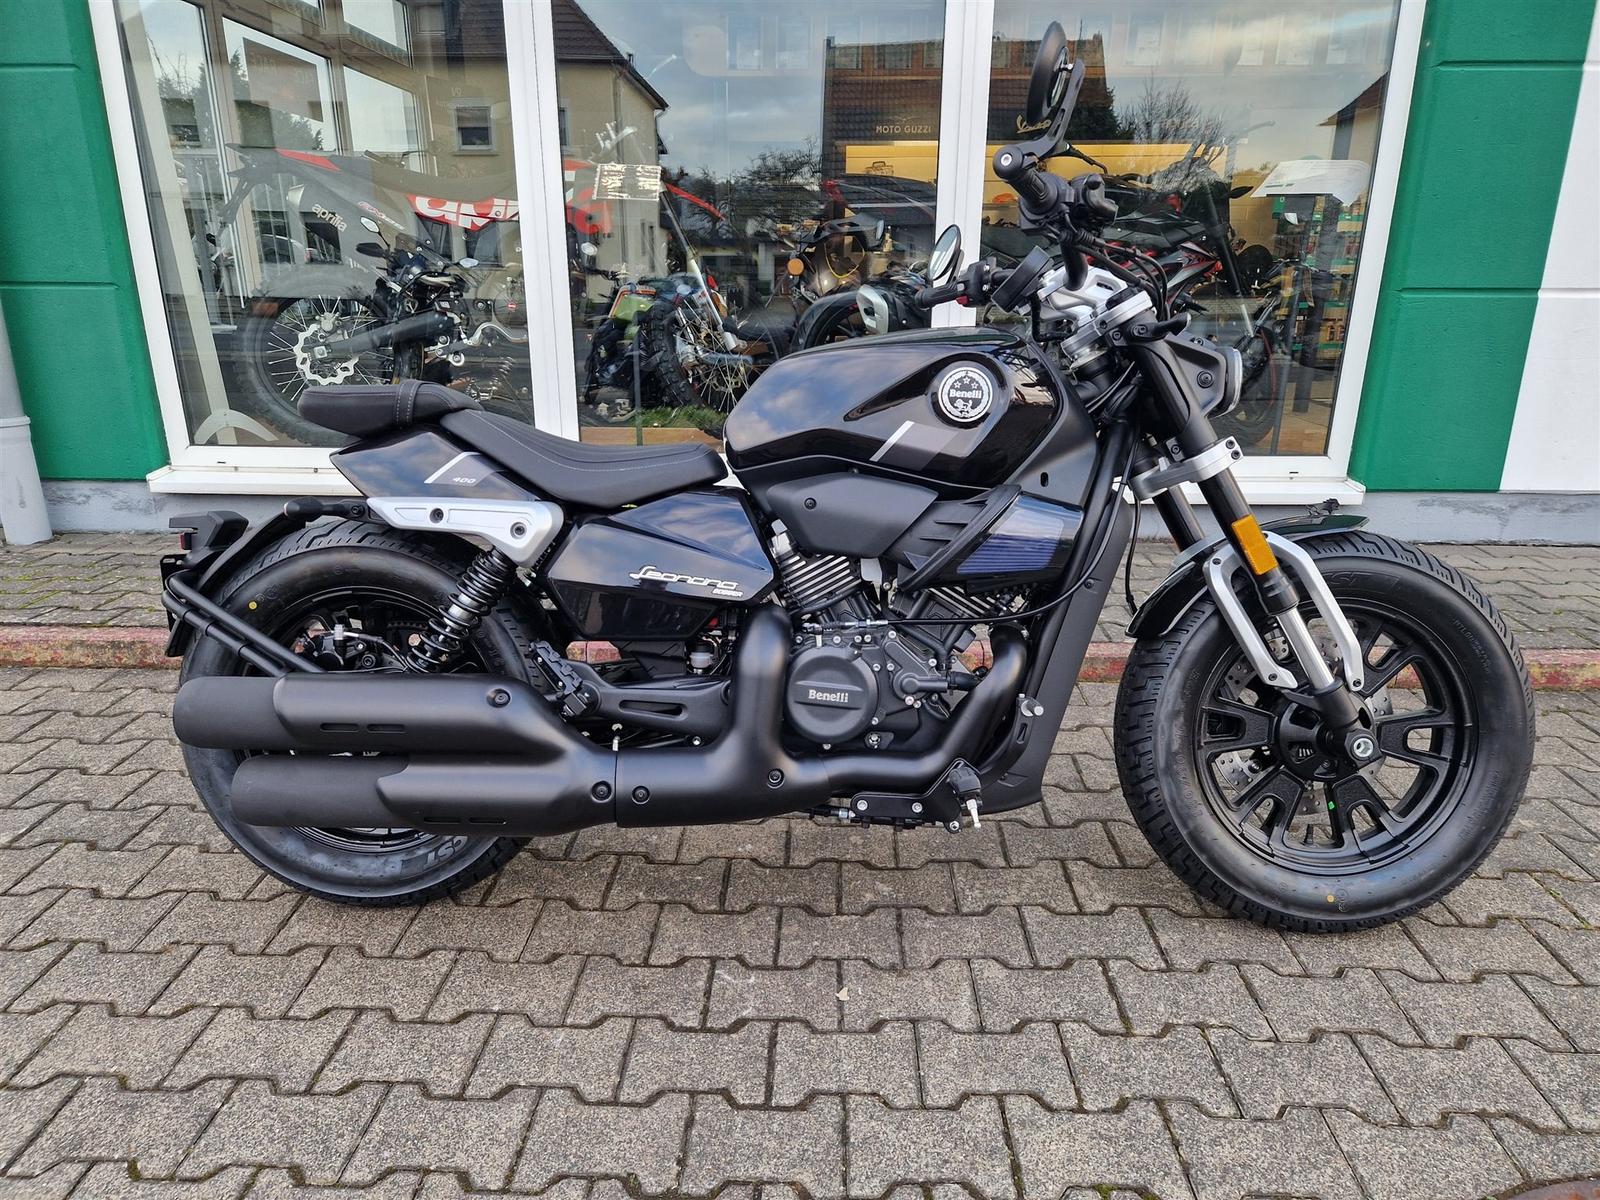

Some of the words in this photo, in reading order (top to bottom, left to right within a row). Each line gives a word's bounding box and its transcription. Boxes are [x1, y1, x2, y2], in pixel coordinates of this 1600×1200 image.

[876, 125, 901, 134] MOTO
[904, 125, 931, 134] GUZZI
[311, 203, 348, 232] aprilia
[949, 388, 982, 399] Benelli
[808, 689, 849, 703] Benelli
